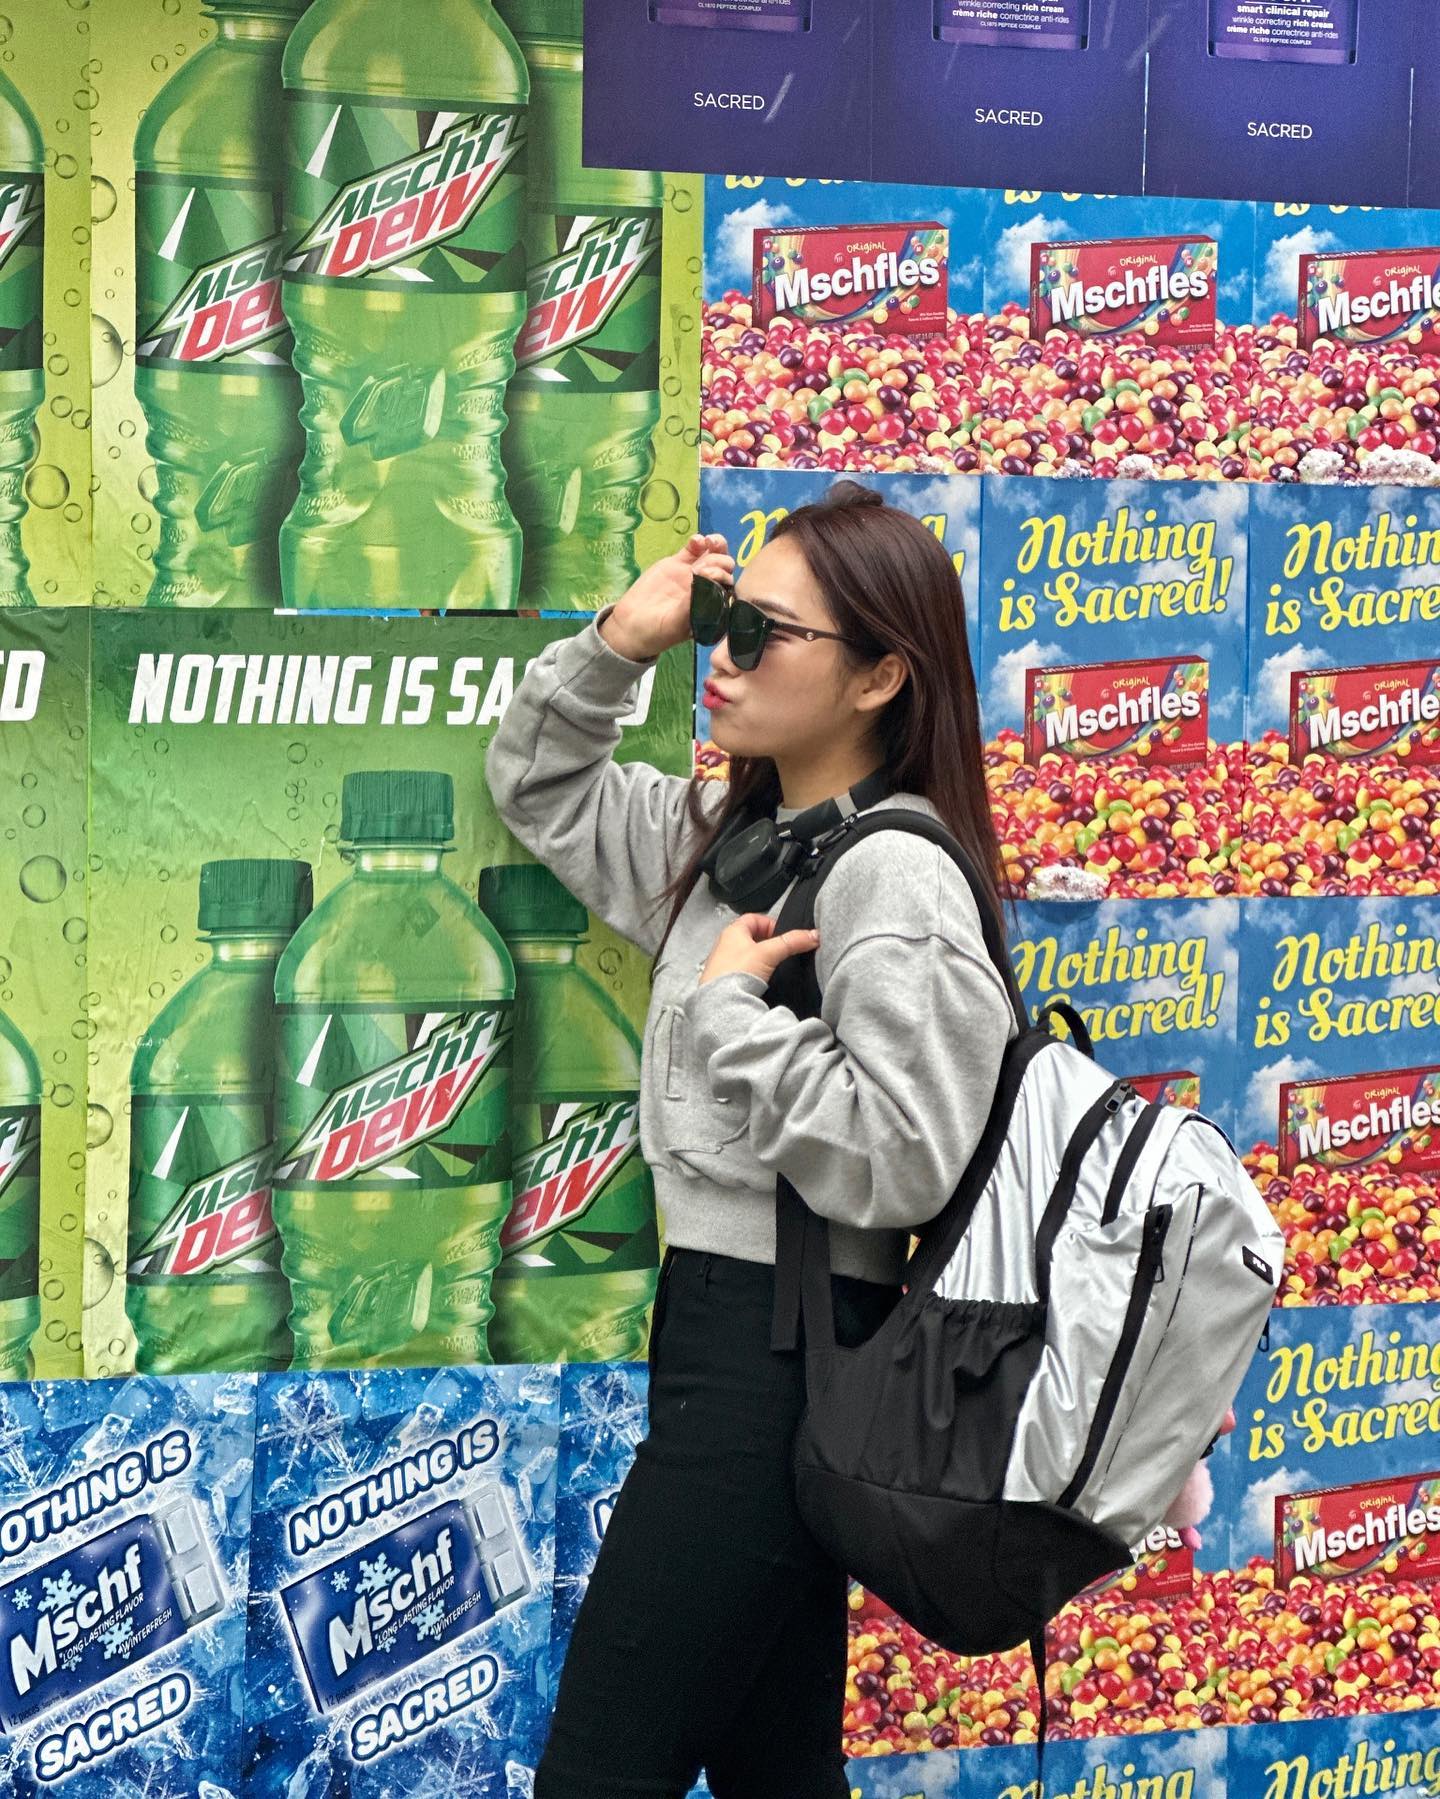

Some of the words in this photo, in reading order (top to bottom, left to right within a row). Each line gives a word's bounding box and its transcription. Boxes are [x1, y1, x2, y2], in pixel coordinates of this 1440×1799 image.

[976, 10, 998, 19] riche
[1022, 4, 1039, 12] rich
[1041, 5, 1064, 13] cream
[1237, 5, 1263, 14] smart
[1265, 6, 1300, 16] clinical
[1303, 8, 1329, 19] repair
[1293, 19, 1309, 28] rich
[694, 92, 765, 111] SACRED
[974, 108, 1043, 127] SACRED
[1247, 122, 1313, 140] SACRED
[774, 251, 940, 312] Mschfles
[1051, 265, 1209, 324] Mschfles
[1319, 274, 1440, 334] Mschfl
[1016, 507, 1217, 574] Nothing
[1283, 512, 1440, 579] Nothin
[998, 577, 1037, 633] is
[1043, 556, 1234, 628] Sacred!
[1264, 583, 1301, 637] is
[1309, 576, 1440, 631] Sacre
[128, 653, 370, 725] NOTHING
[381, 655, 438, 726] IS
[1045, 686, 1201, 748] Mschfles
[1310, 687, 1440, 749] Mschfle
[1010, 925, 1208, 992] Nothing
[1272, 922, 1440, 992] Nothin
[1253, 996, 1291, 1049] is
[1298, 987, 1440, 1042] Sacre
[1248, 1408, 1285, 1462] is
[1291, 1397, 1440, 1453] Sacre
[0, 1455, 145, 1556] OTHING
[148, 1431, 191, 1482] IS
[292, 1444, 455, 1553] NOTHING
[459, 1421, 498, 1470] IS
[10, 1543, 142, 1697] Mschf
[62, 1643, 85, 1663] LONG
[83, 1617, 116, 1648] LASTING
[115, 1592, 144, 1623] FLAVOR
[119, 1607, 173, 1654] WINTERFRESH
[329, 1528, 452, 1677] Mschf
[378, 1624, 399, 1644] LONG
[398, 1599, 428, 1631] LASTING
[427, 1575, 455, 1605] FLAVOR
[432, 1590, 482, 1636] WINTERFRESH
[40, 1679, 188, 1777] SACRED
[354, 1660, 496, 1758] SACRED
